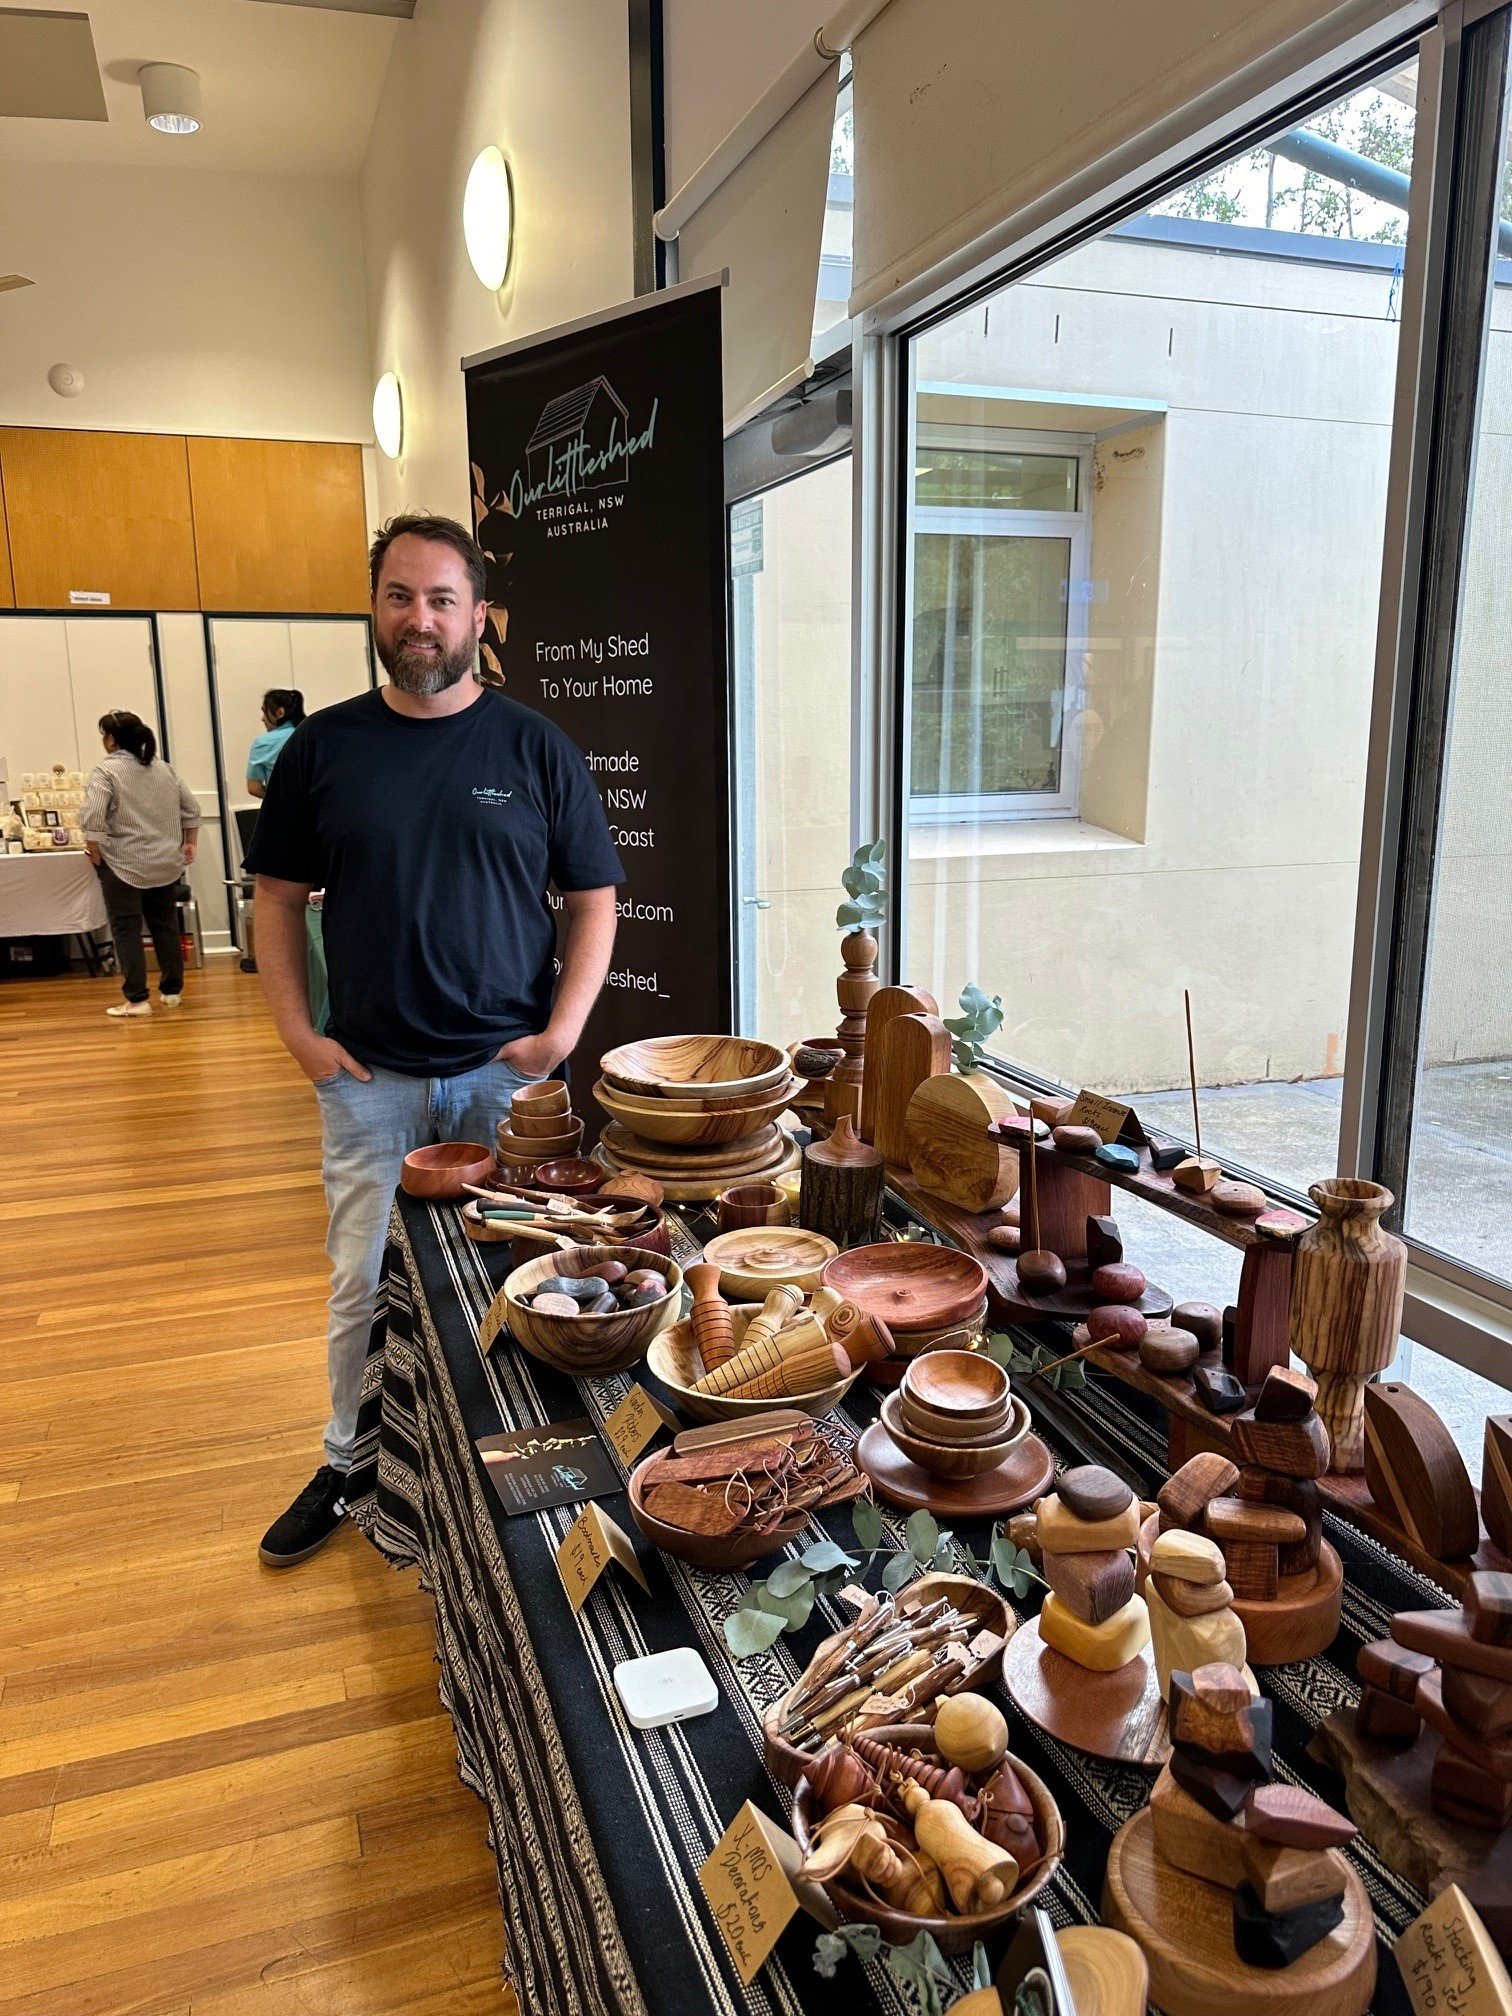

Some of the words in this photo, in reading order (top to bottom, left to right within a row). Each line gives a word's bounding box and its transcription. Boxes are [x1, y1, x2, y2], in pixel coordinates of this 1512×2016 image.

[536, 502, 593, 521] TERRIGAL,
[598, 494, 624, 510] NSW
[547, 517, 609, 538] AUSTRALIA
[535, 642, 575, 662] From
[580, 638, 603, 664] My
[607, 632, 649, 658] Shed
[540, 678, 560, 699] To
[562, 677, 598, 698] Your
[603, 675, 653, 696] Home
[585, 750, 639, 772] dmade
[607, 788, 647, 810] NSW
[1080, 1091, 1101, 1106] Small
[577, 1516, 601, 1568] Bookmarks
[719, 1851, 767, 1933] Decorations
[1442, 1916, 1476, 1995] Stacking
[1411, 1959, 1437, 2009] $190
[1442, 1986, 1468, 2014] set
